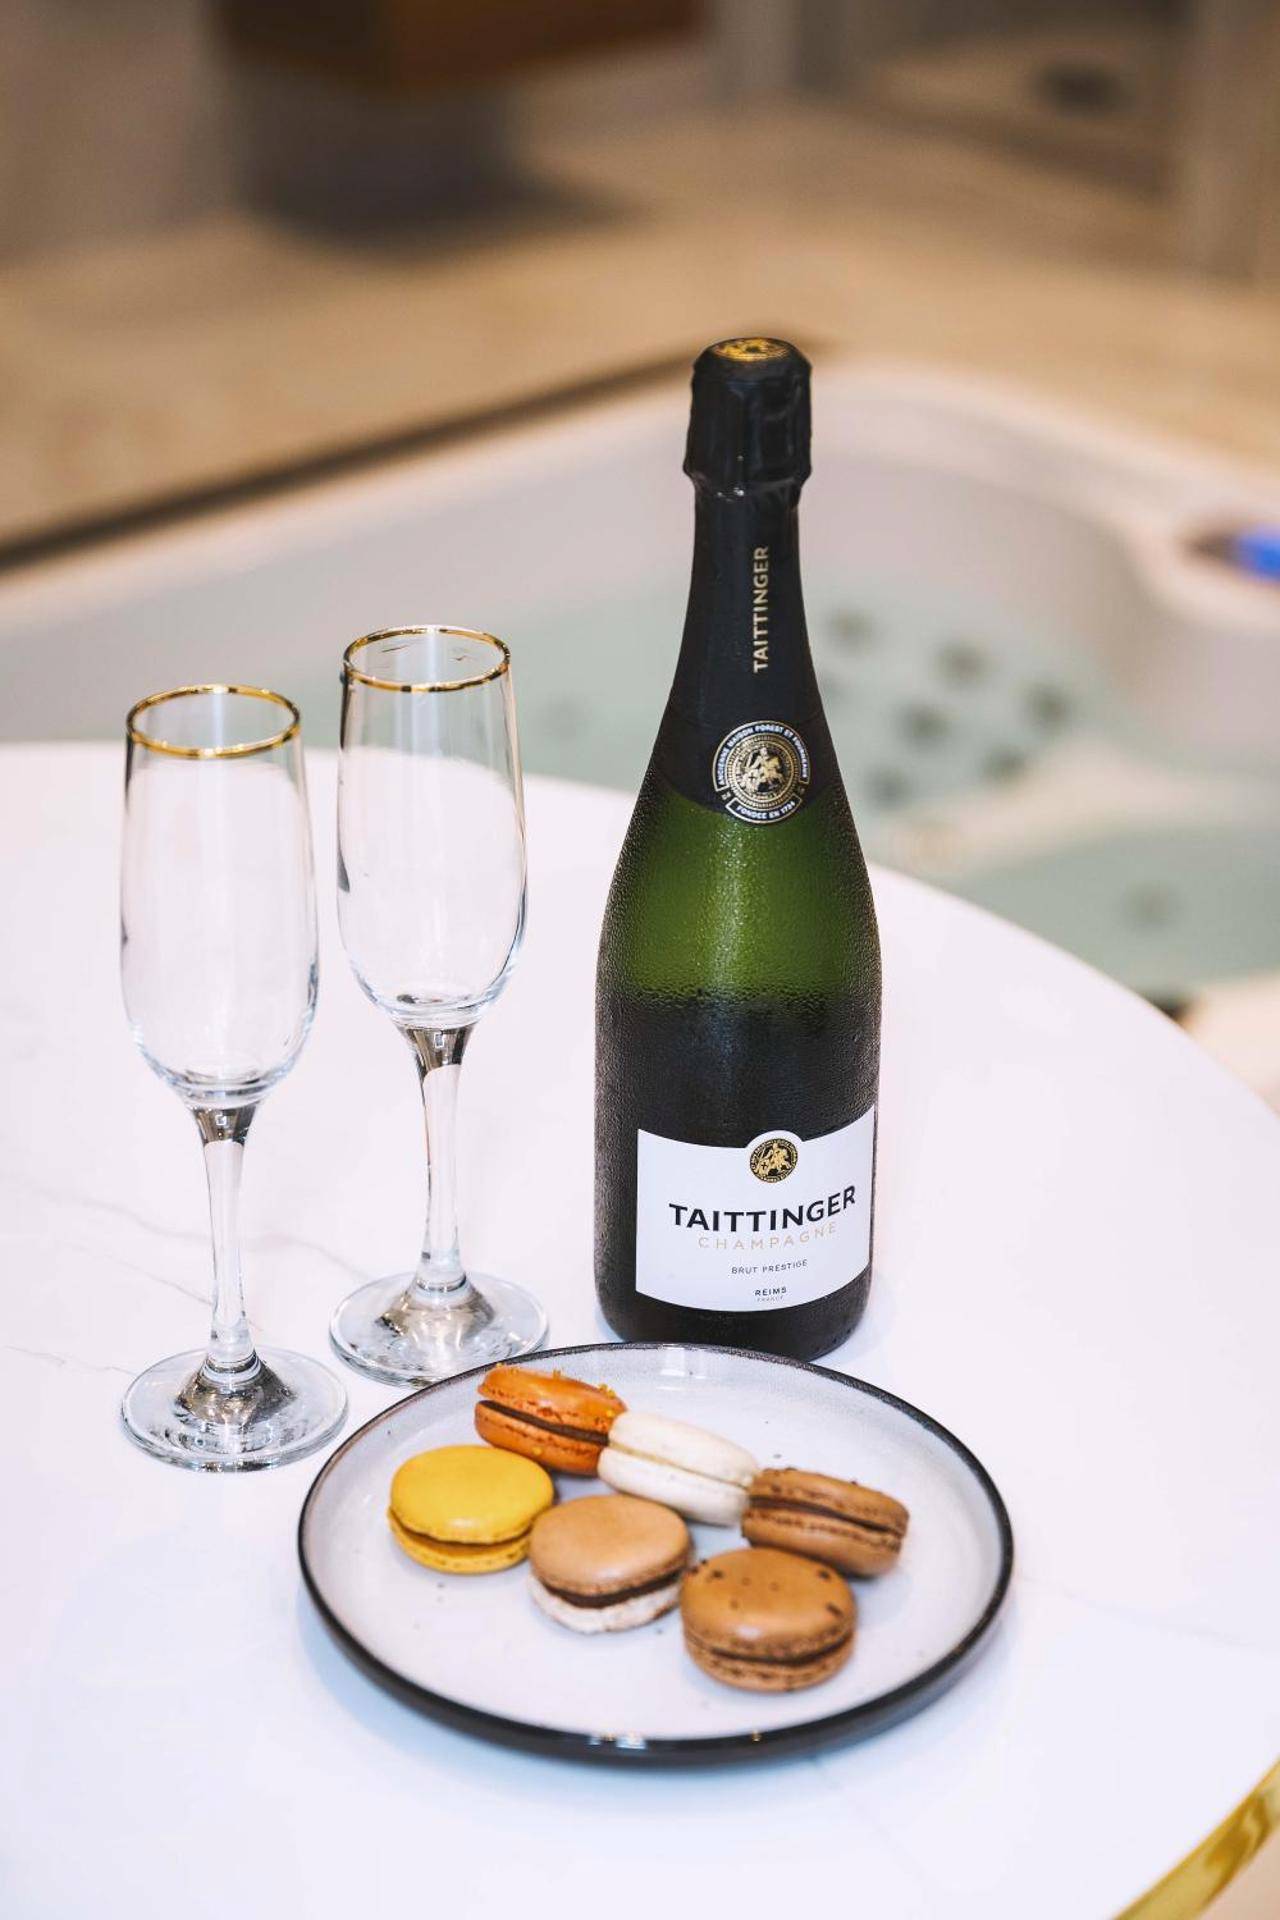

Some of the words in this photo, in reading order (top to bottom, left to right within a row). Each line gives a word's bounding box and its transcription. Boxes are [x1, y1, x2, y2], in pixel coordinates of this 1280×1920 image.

[753, 546, 769, 673] TAITTINGER
[755, 724, 784, 733] FOREST
[783, 729, 794, 738] ET
[768, 810, 781, 819] EN
[668, 1185, 856, 1233] TAITTINGER
[697, 1221, 838, 1250] CHAMPAGNE
[731, 1265, 759, 1275] BRUT
[762, 1259, 808, 1273] PRESTIGE
[754, 1287, 787, 1296] REIMS
